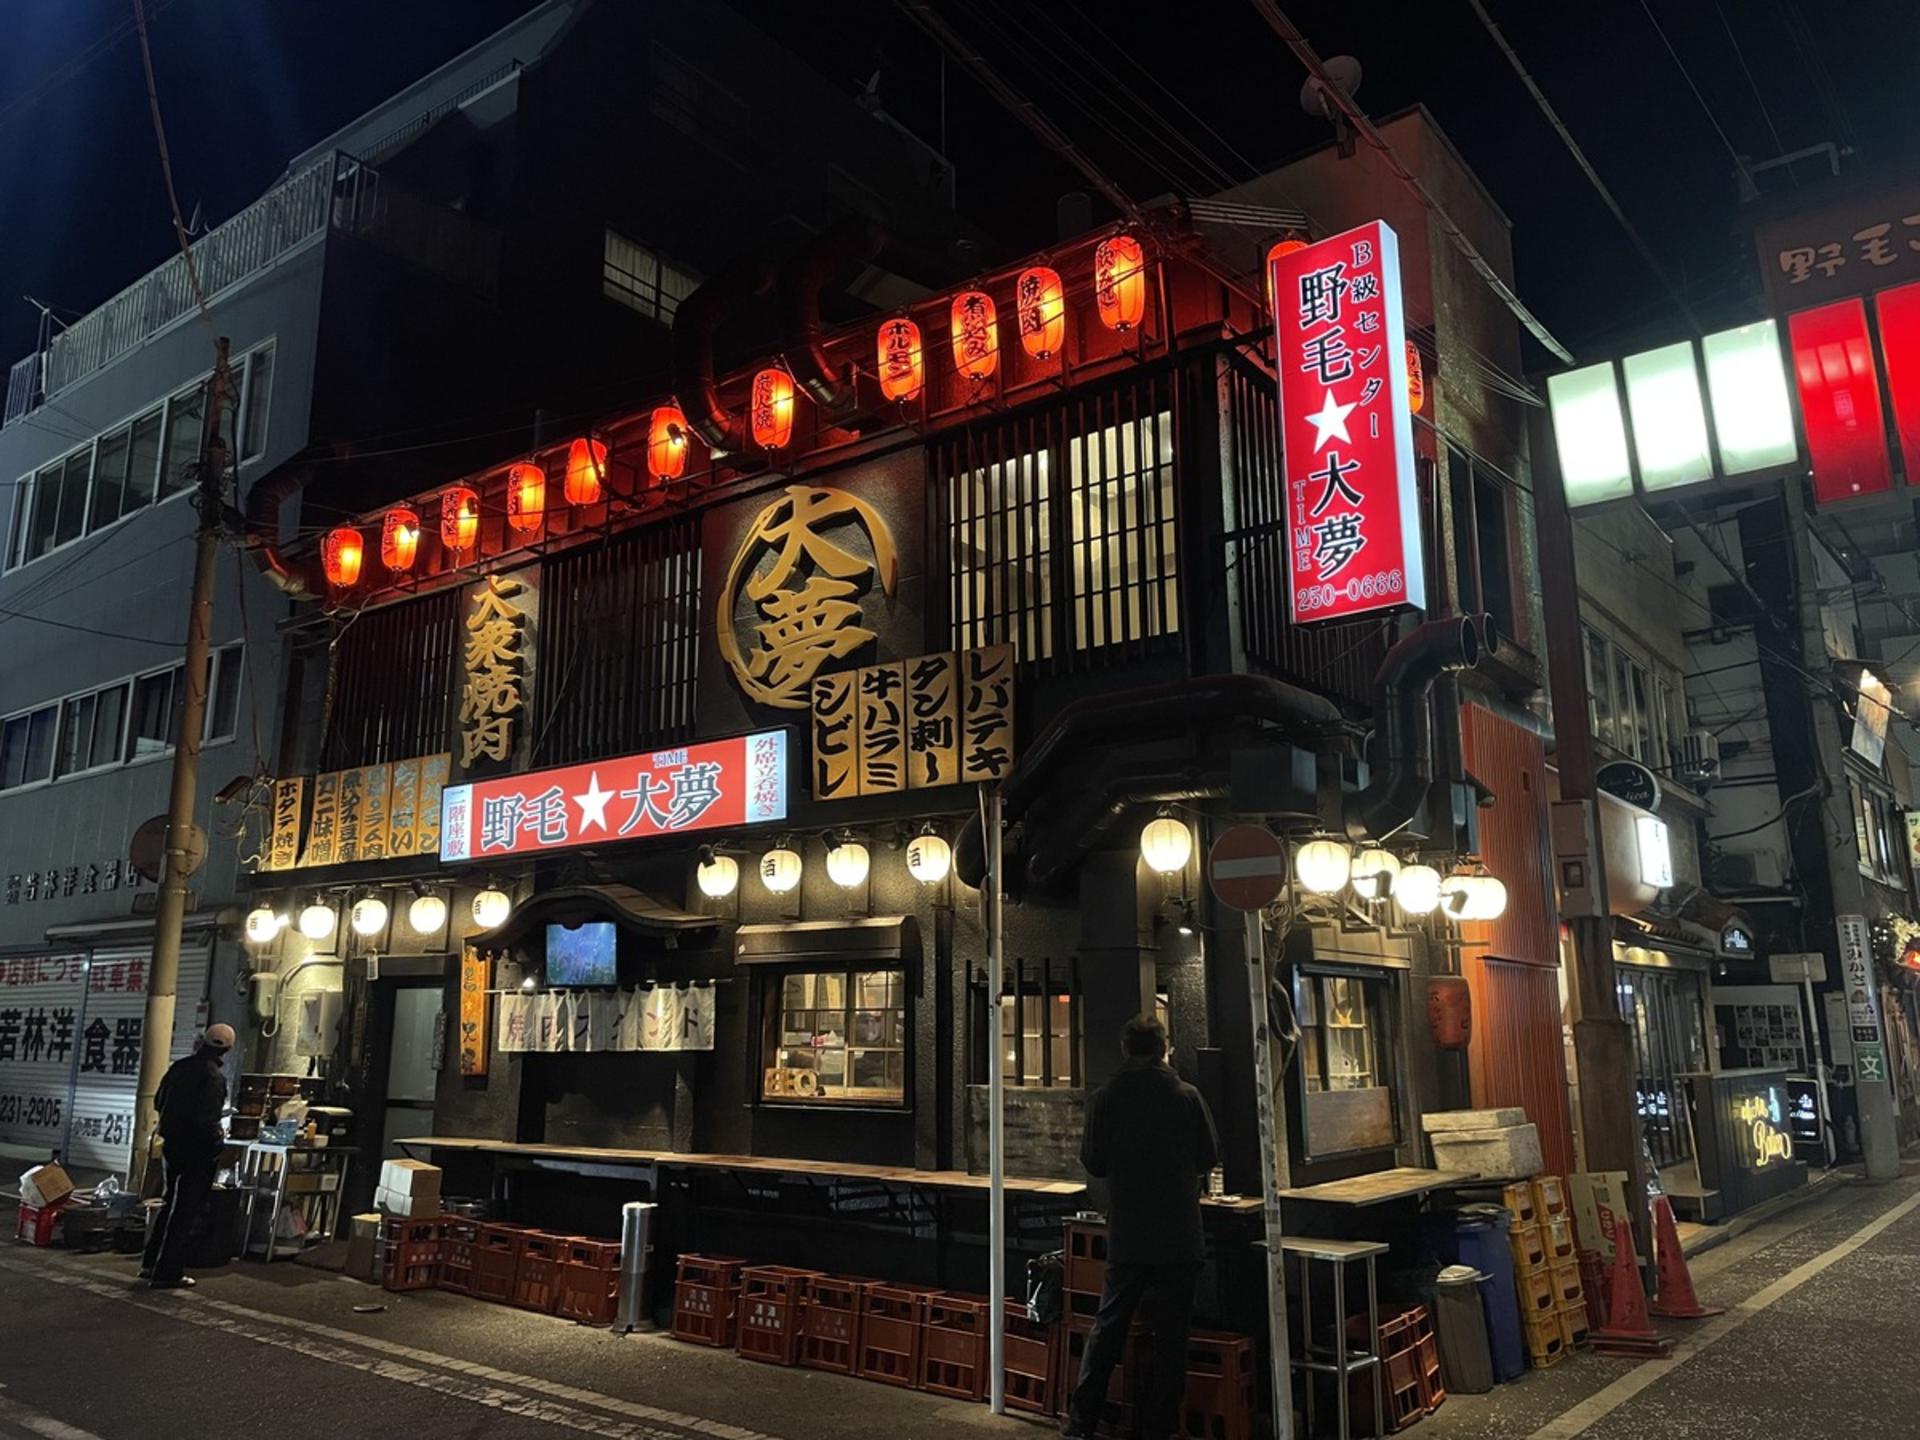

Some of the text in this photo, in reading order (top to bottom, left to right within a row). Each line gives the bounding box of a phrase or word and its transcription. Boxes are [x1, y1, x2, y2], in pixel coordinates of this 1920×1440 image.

[886, 322, 912, 381] ホルモン
[1351, 242, 1384, 438] B級センター
[1299, 262, 1367, 583] 野毛 大夢
[1293, 480, 1312, 572] TIME
[747, 484, 878, 706] 大夢
[1297, 571, 1402, 612] 250-0666
[460, 574, 526, 768] 大衆焼肉
[966, 652, 1011, 778] レバテキ
[653, 749, 688, 767] TIME
[815, 678, 853, 797] シビレ
[863, 668, 902, 789] 牛ハラミ
[274, 783, 296, 867] ホタテ焼き
[446, 788, 466, 858] 二階座敷
[482, 786, 569, 850] 野毛
[620, 763, 722, 834] 大夢
